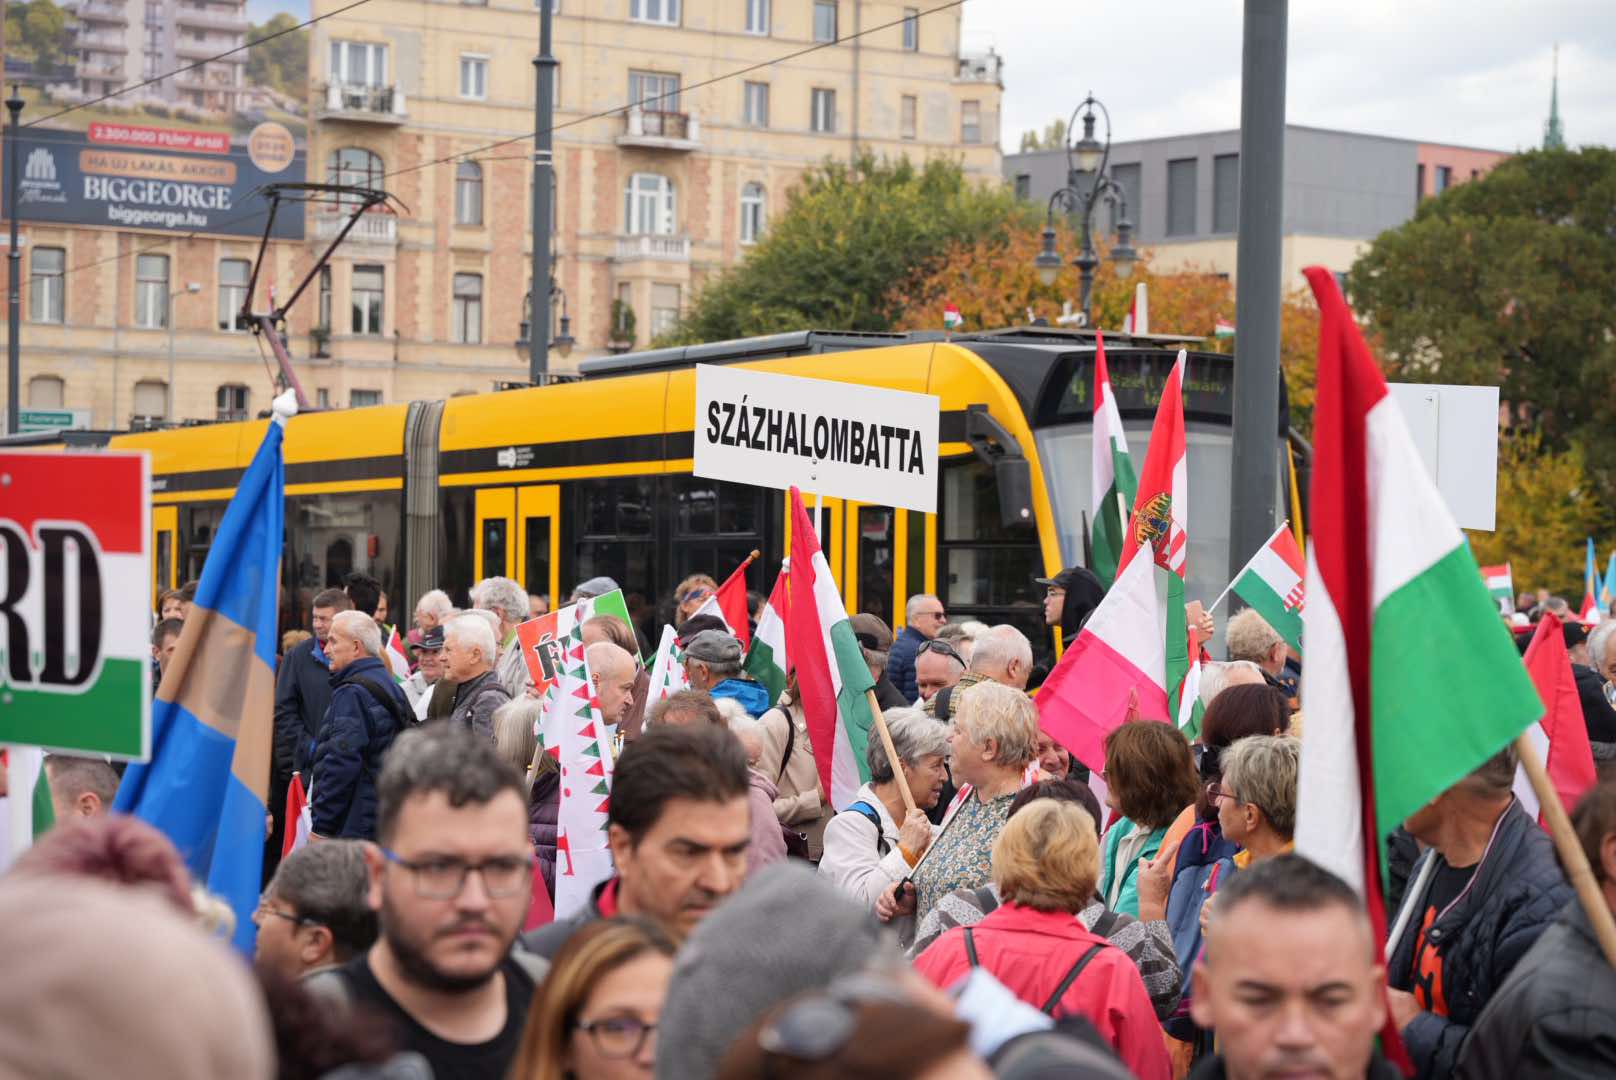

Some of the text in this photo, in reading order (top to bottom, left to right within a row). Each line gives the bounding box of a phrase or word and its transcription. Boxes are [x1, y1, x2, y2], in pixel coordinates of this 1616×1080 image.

[83, 176, 233, 210] BIGGEORGE
[108, 204, 208, 227] biggeorge.hu
[706, 394, 925, 475] SZÁZHALOMBATTA
